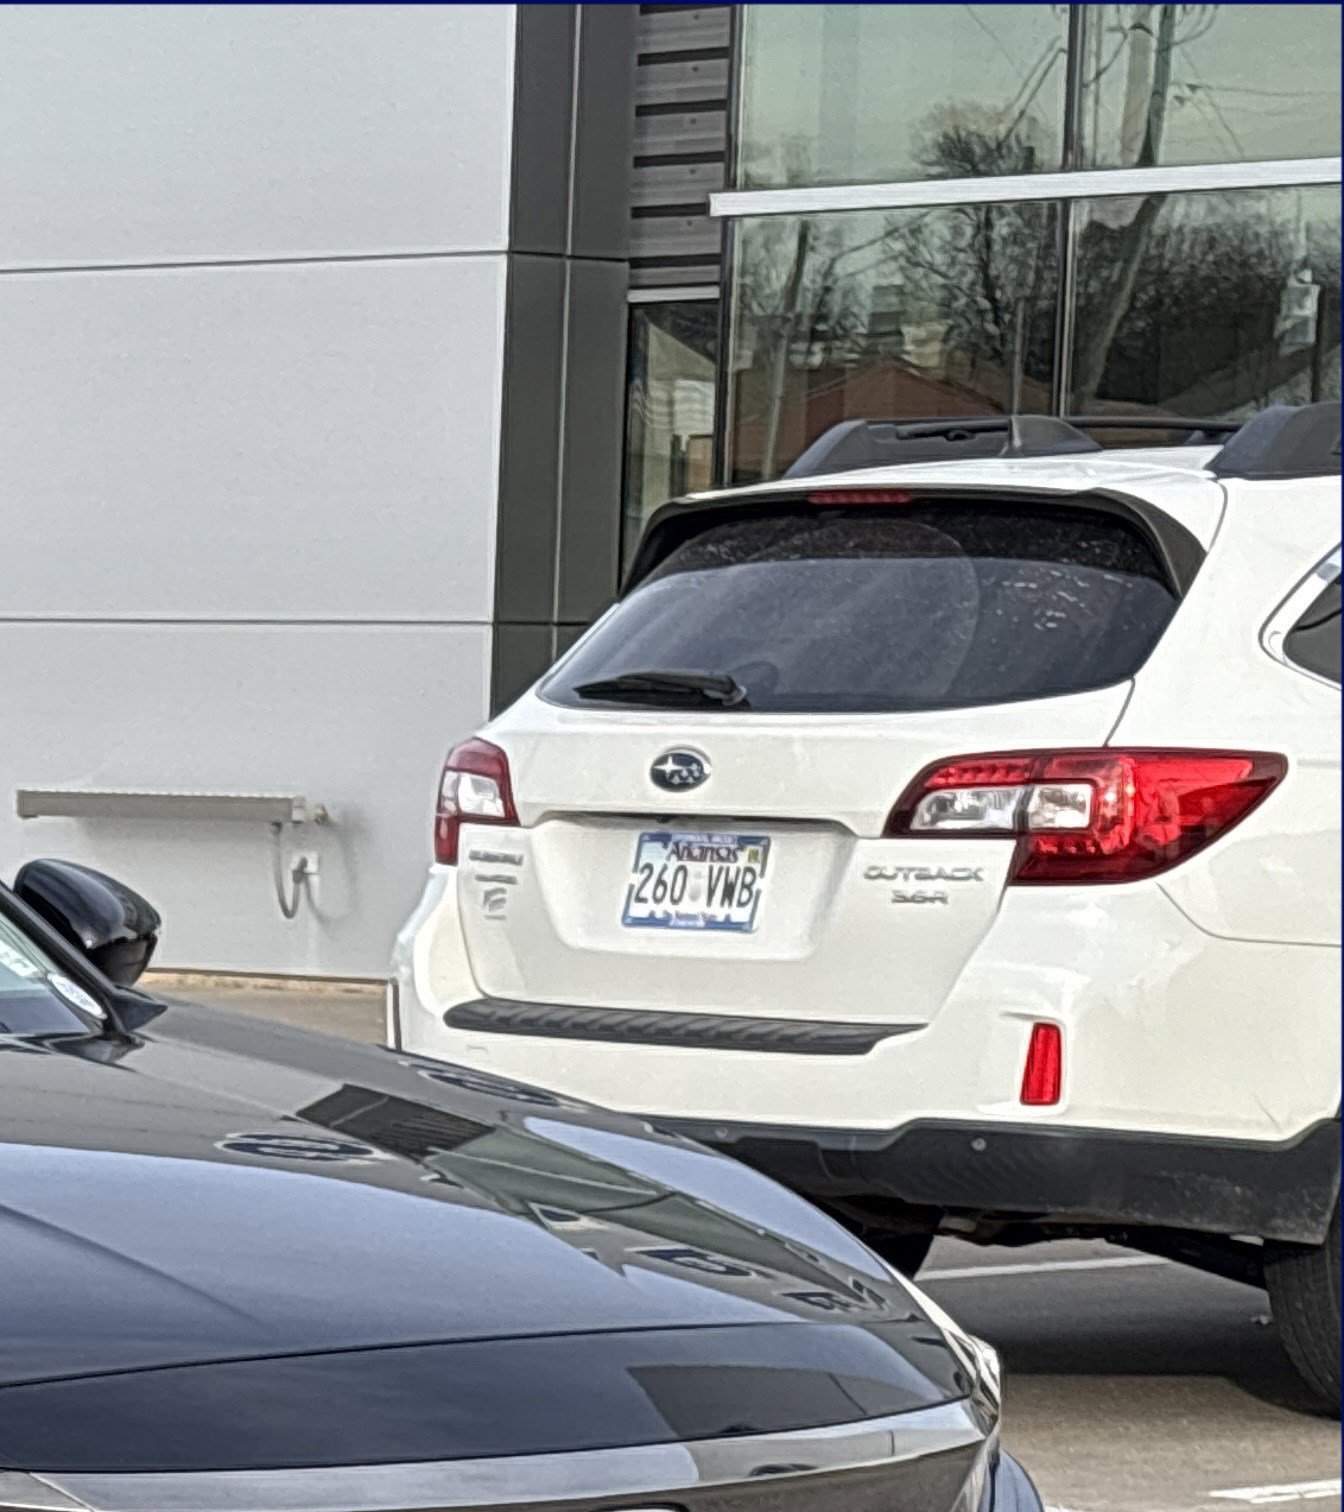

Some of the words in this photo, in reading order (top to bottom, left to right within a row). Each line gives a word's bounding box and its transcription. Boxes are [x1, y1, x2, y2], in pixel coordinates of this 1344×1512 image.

[634, 863, 689, 906] 260
[706, 864, 758, 908] VWB
[863, 865, 984, 881] OUTBACK
